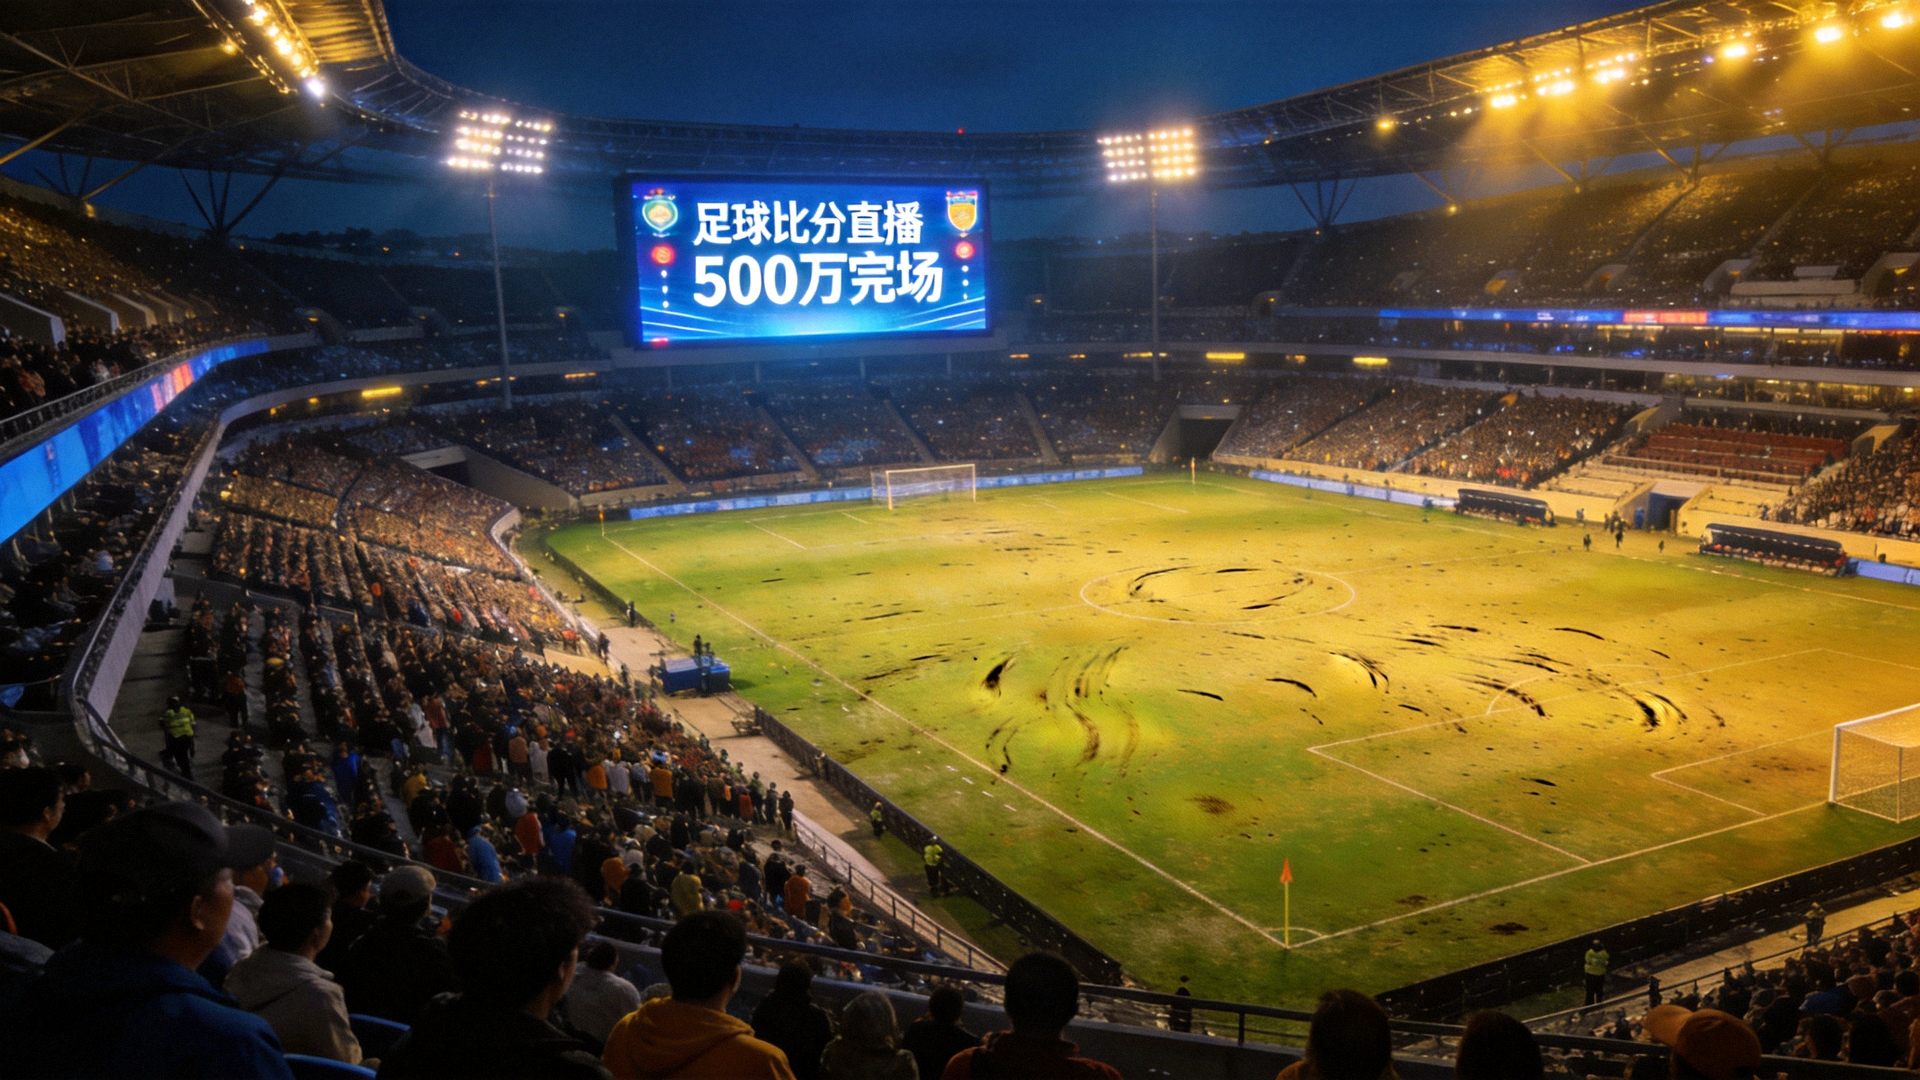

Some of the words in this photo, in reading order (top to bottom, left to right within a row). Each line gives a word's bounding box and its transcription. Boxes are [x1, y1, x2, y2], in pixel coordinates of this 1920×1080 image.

[693, 200, 924, 246] 足球比分直播
[693, 250, 944, 307] 500万完场
